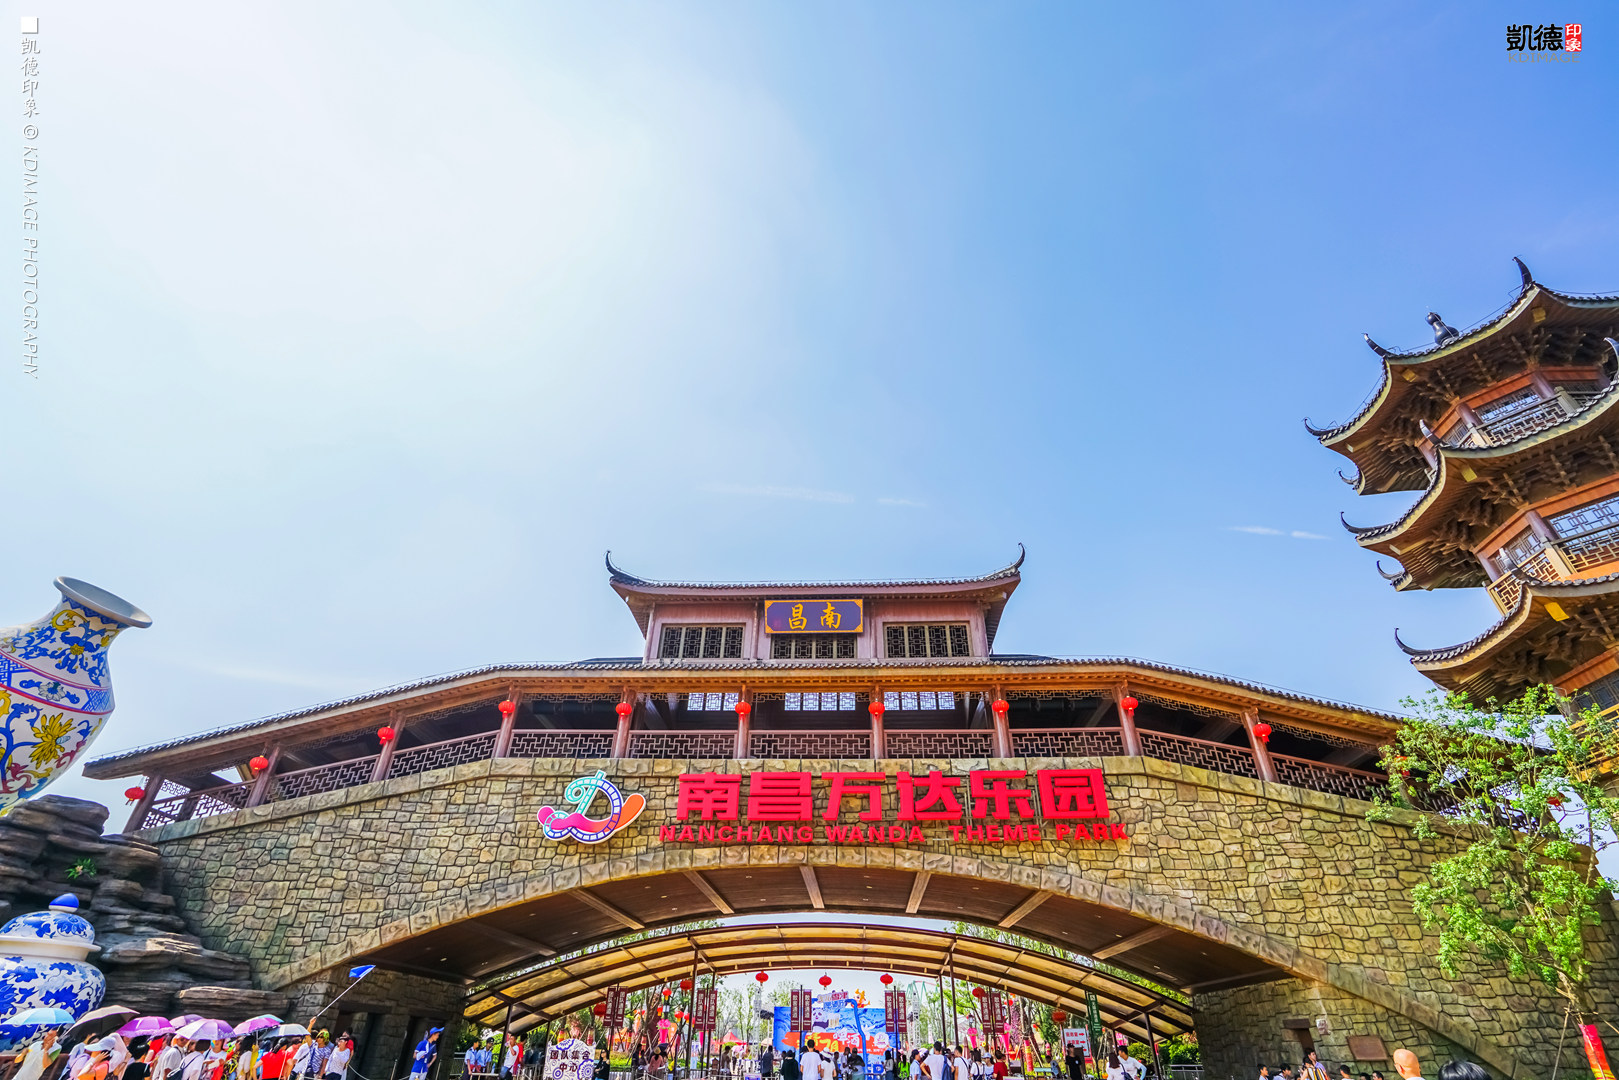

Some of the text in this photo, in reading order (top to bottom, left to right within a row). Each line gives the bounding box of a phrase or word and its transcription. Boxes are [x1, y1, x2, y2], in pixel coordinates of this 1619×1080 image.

[677, 768, 1110, 822] 南昌万达乐园
[659, 822, 1129, 843] NANCHANG WANDA THEME PARK
[559, 1062, 578, 1073] 中心
